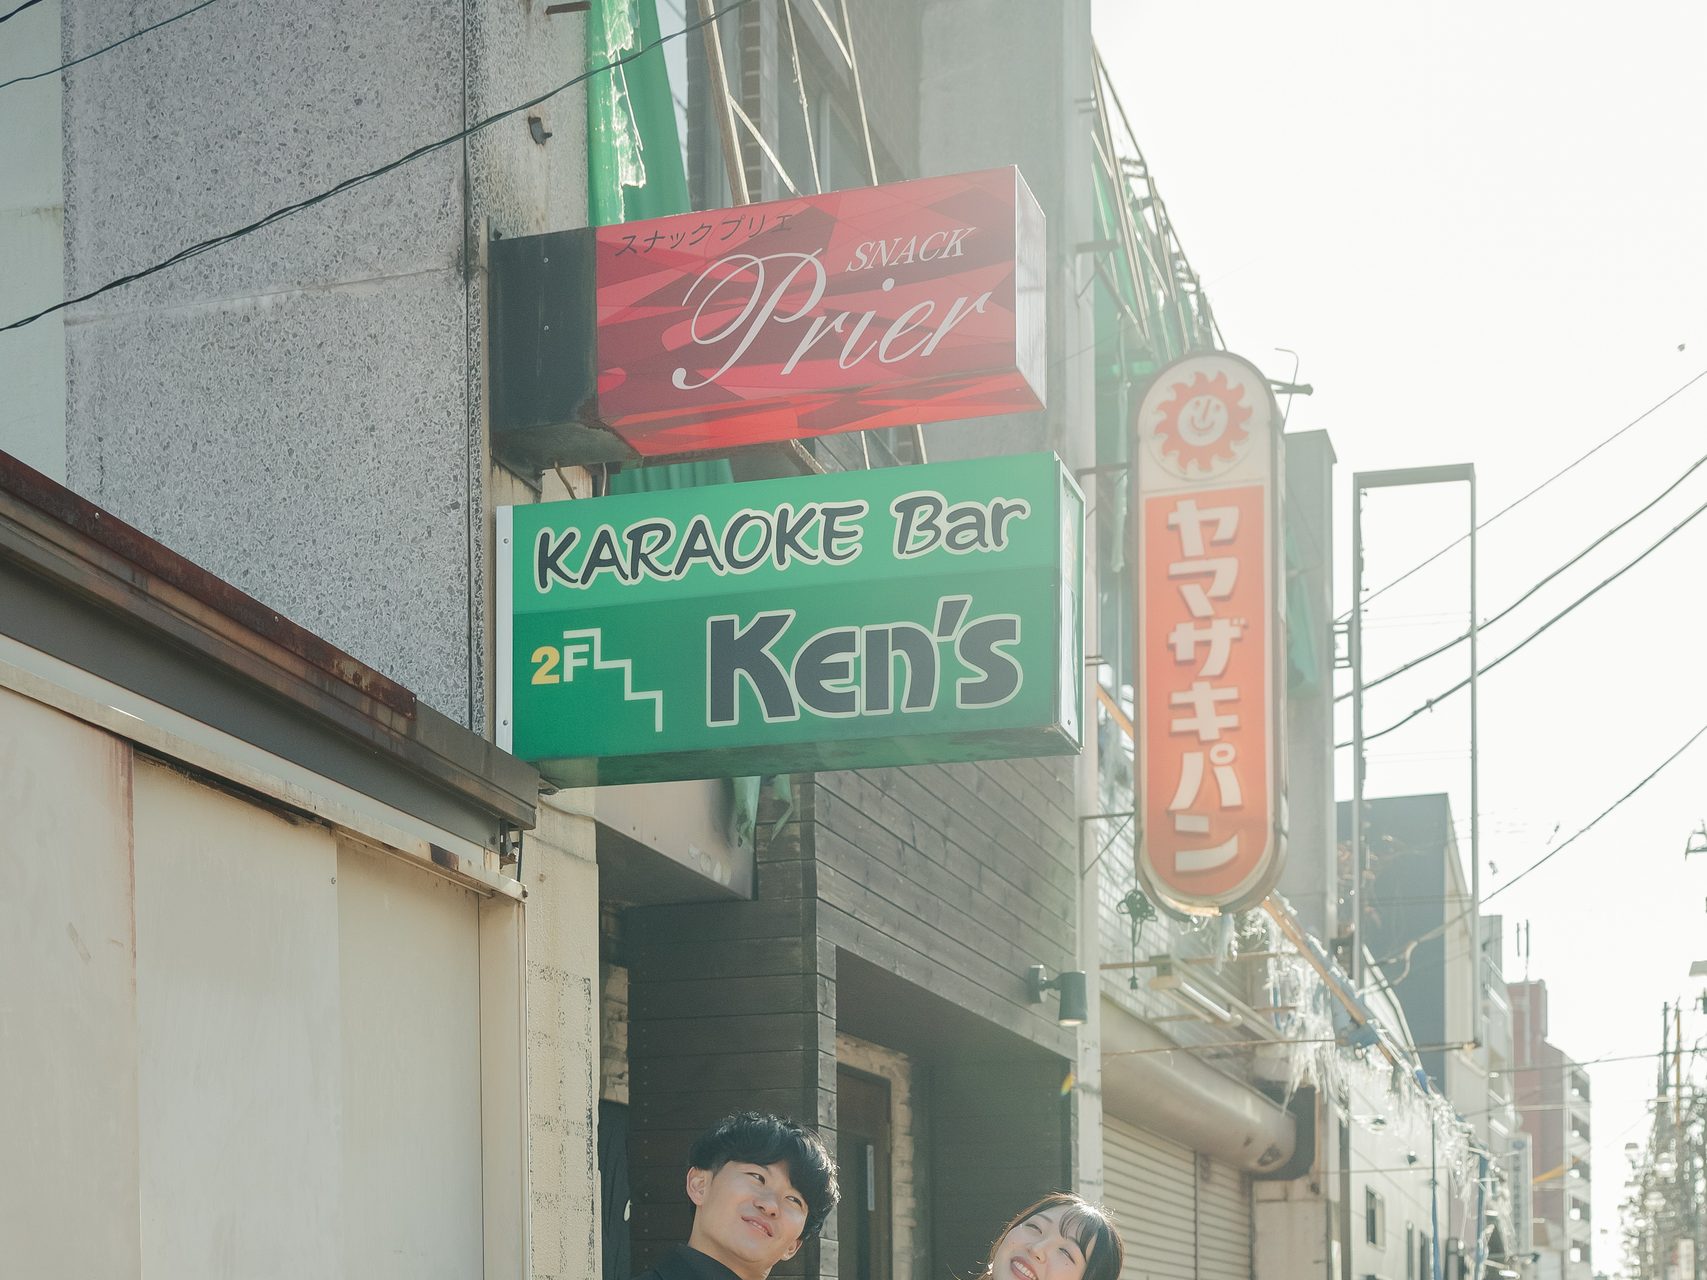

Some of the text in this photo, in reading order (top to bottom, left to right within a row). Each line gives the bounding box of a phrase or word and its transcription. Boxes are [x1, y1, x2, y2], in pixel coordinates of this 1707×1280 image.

[613, 211, 795, 257] スナックプリエ
[845, 226, 977, 273] SNACK
[671, 246, 993, 390] Prier
[535, 491, 1030, 593] KARAOKE Bar
[530, 643, 591, 686] 2F
[707, 595, 1024, 727] Ken's
[1167, 500, 1248, 873] ヤマザキパン
